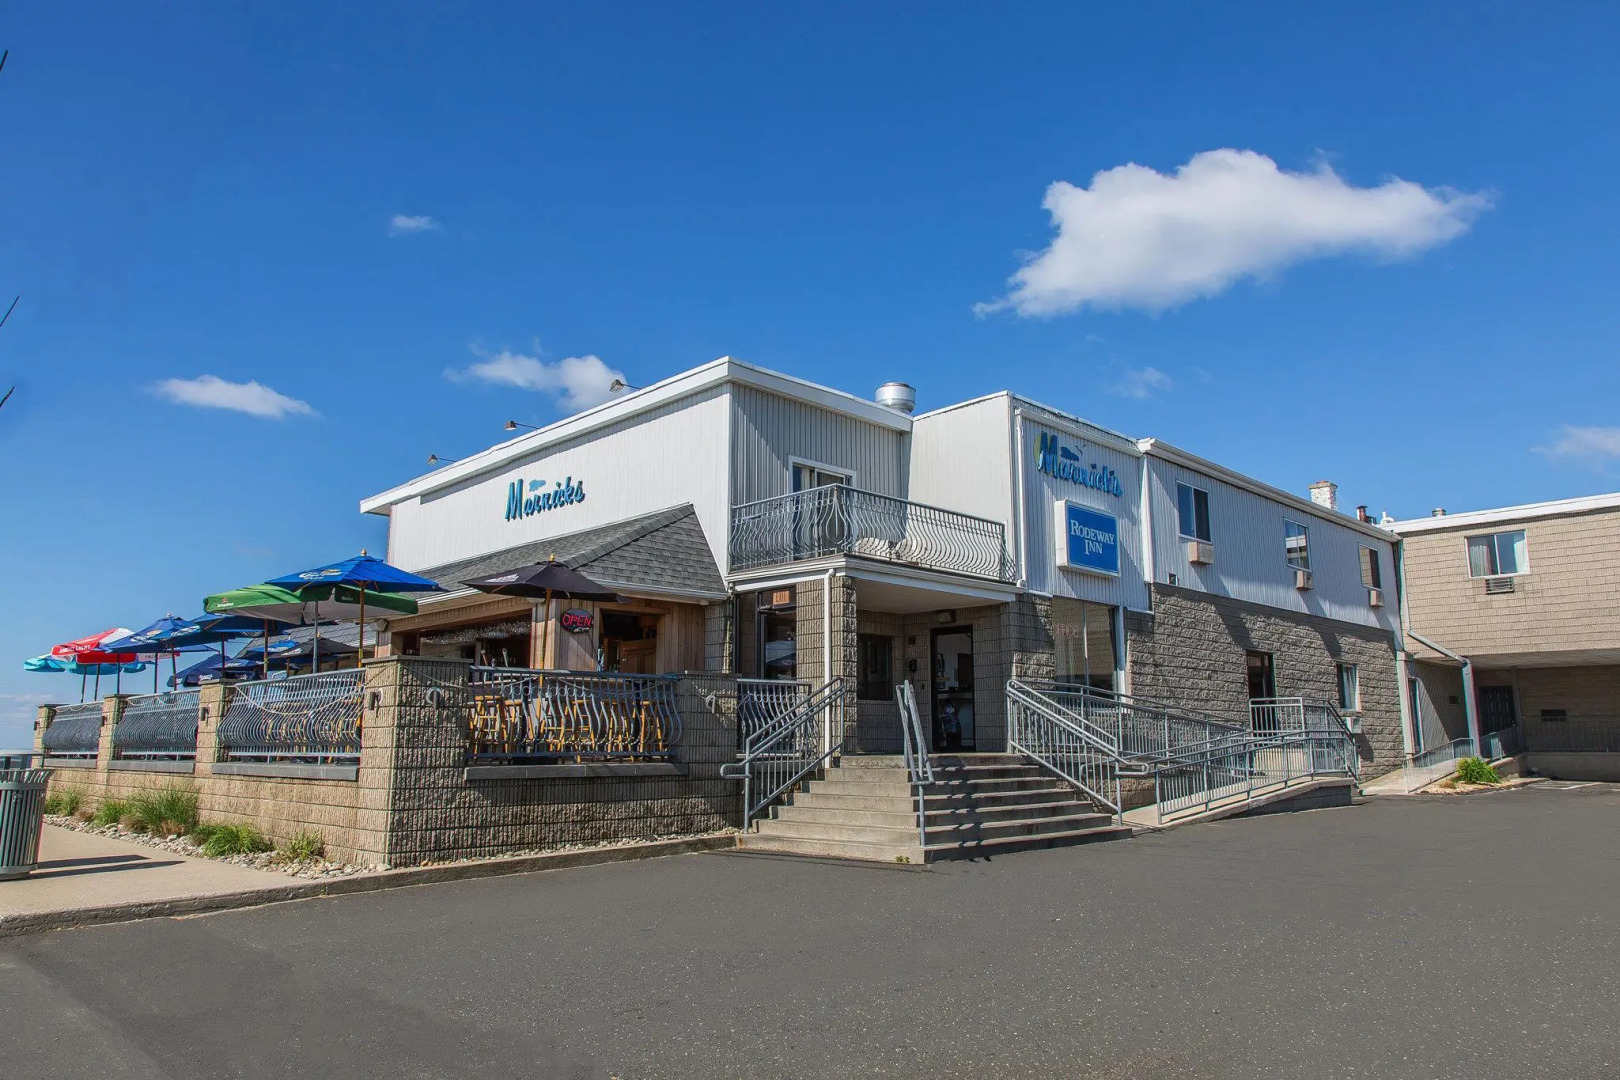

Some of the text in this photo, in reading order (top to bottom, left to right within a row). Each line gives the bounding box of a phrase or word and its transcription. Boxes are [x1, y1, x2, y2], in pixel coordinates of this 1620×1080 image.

[1070, 519, 1115, 544] RODEWAY
[1084, 540, 1103, 555] INN
[562, 611, 592, 627] OPEN
